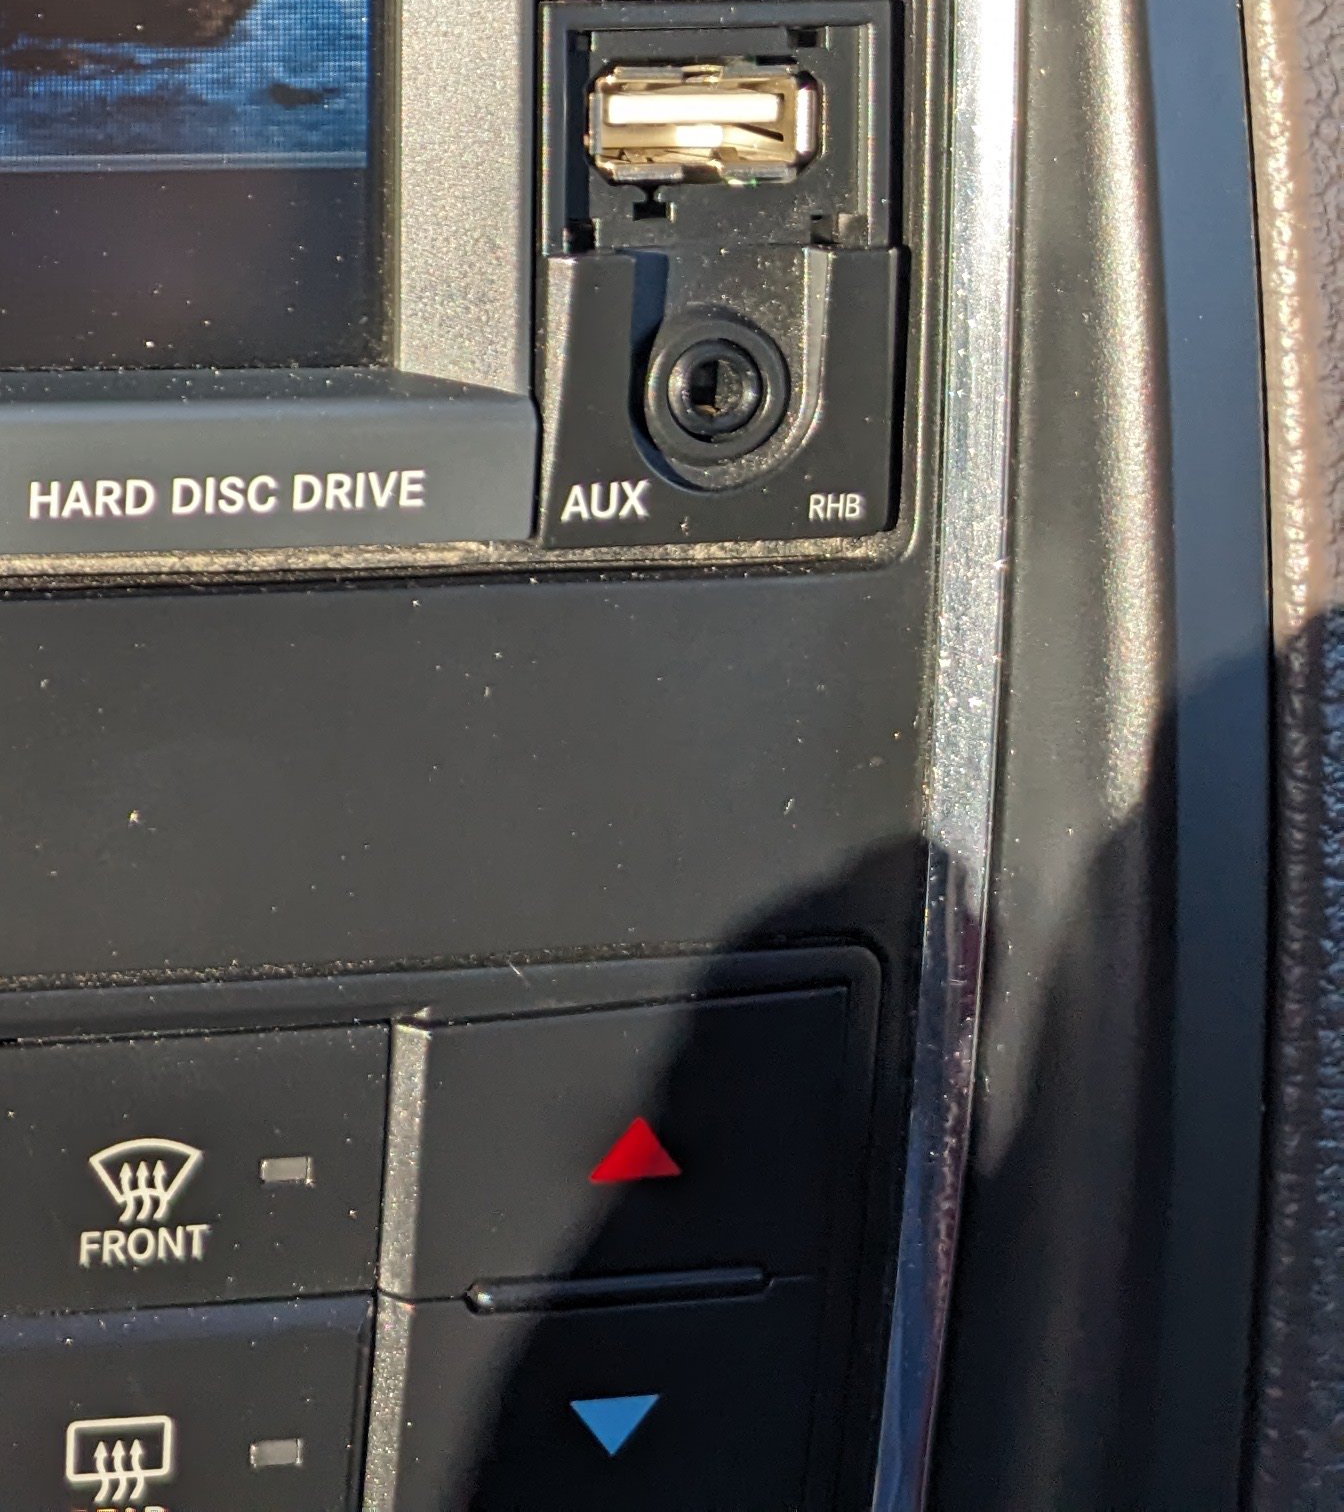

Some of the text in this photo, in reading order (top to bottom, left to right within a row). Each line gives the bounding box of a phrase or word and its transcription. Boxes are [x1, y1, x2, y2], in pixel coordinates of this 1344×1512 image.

[28, 470, 427, 520] HARD DISC DRIVE
[561, 480, 650, 521] AUX
[809, 492, 865, 520] RHB
[79, 1224, 210, 1266] FRONT
